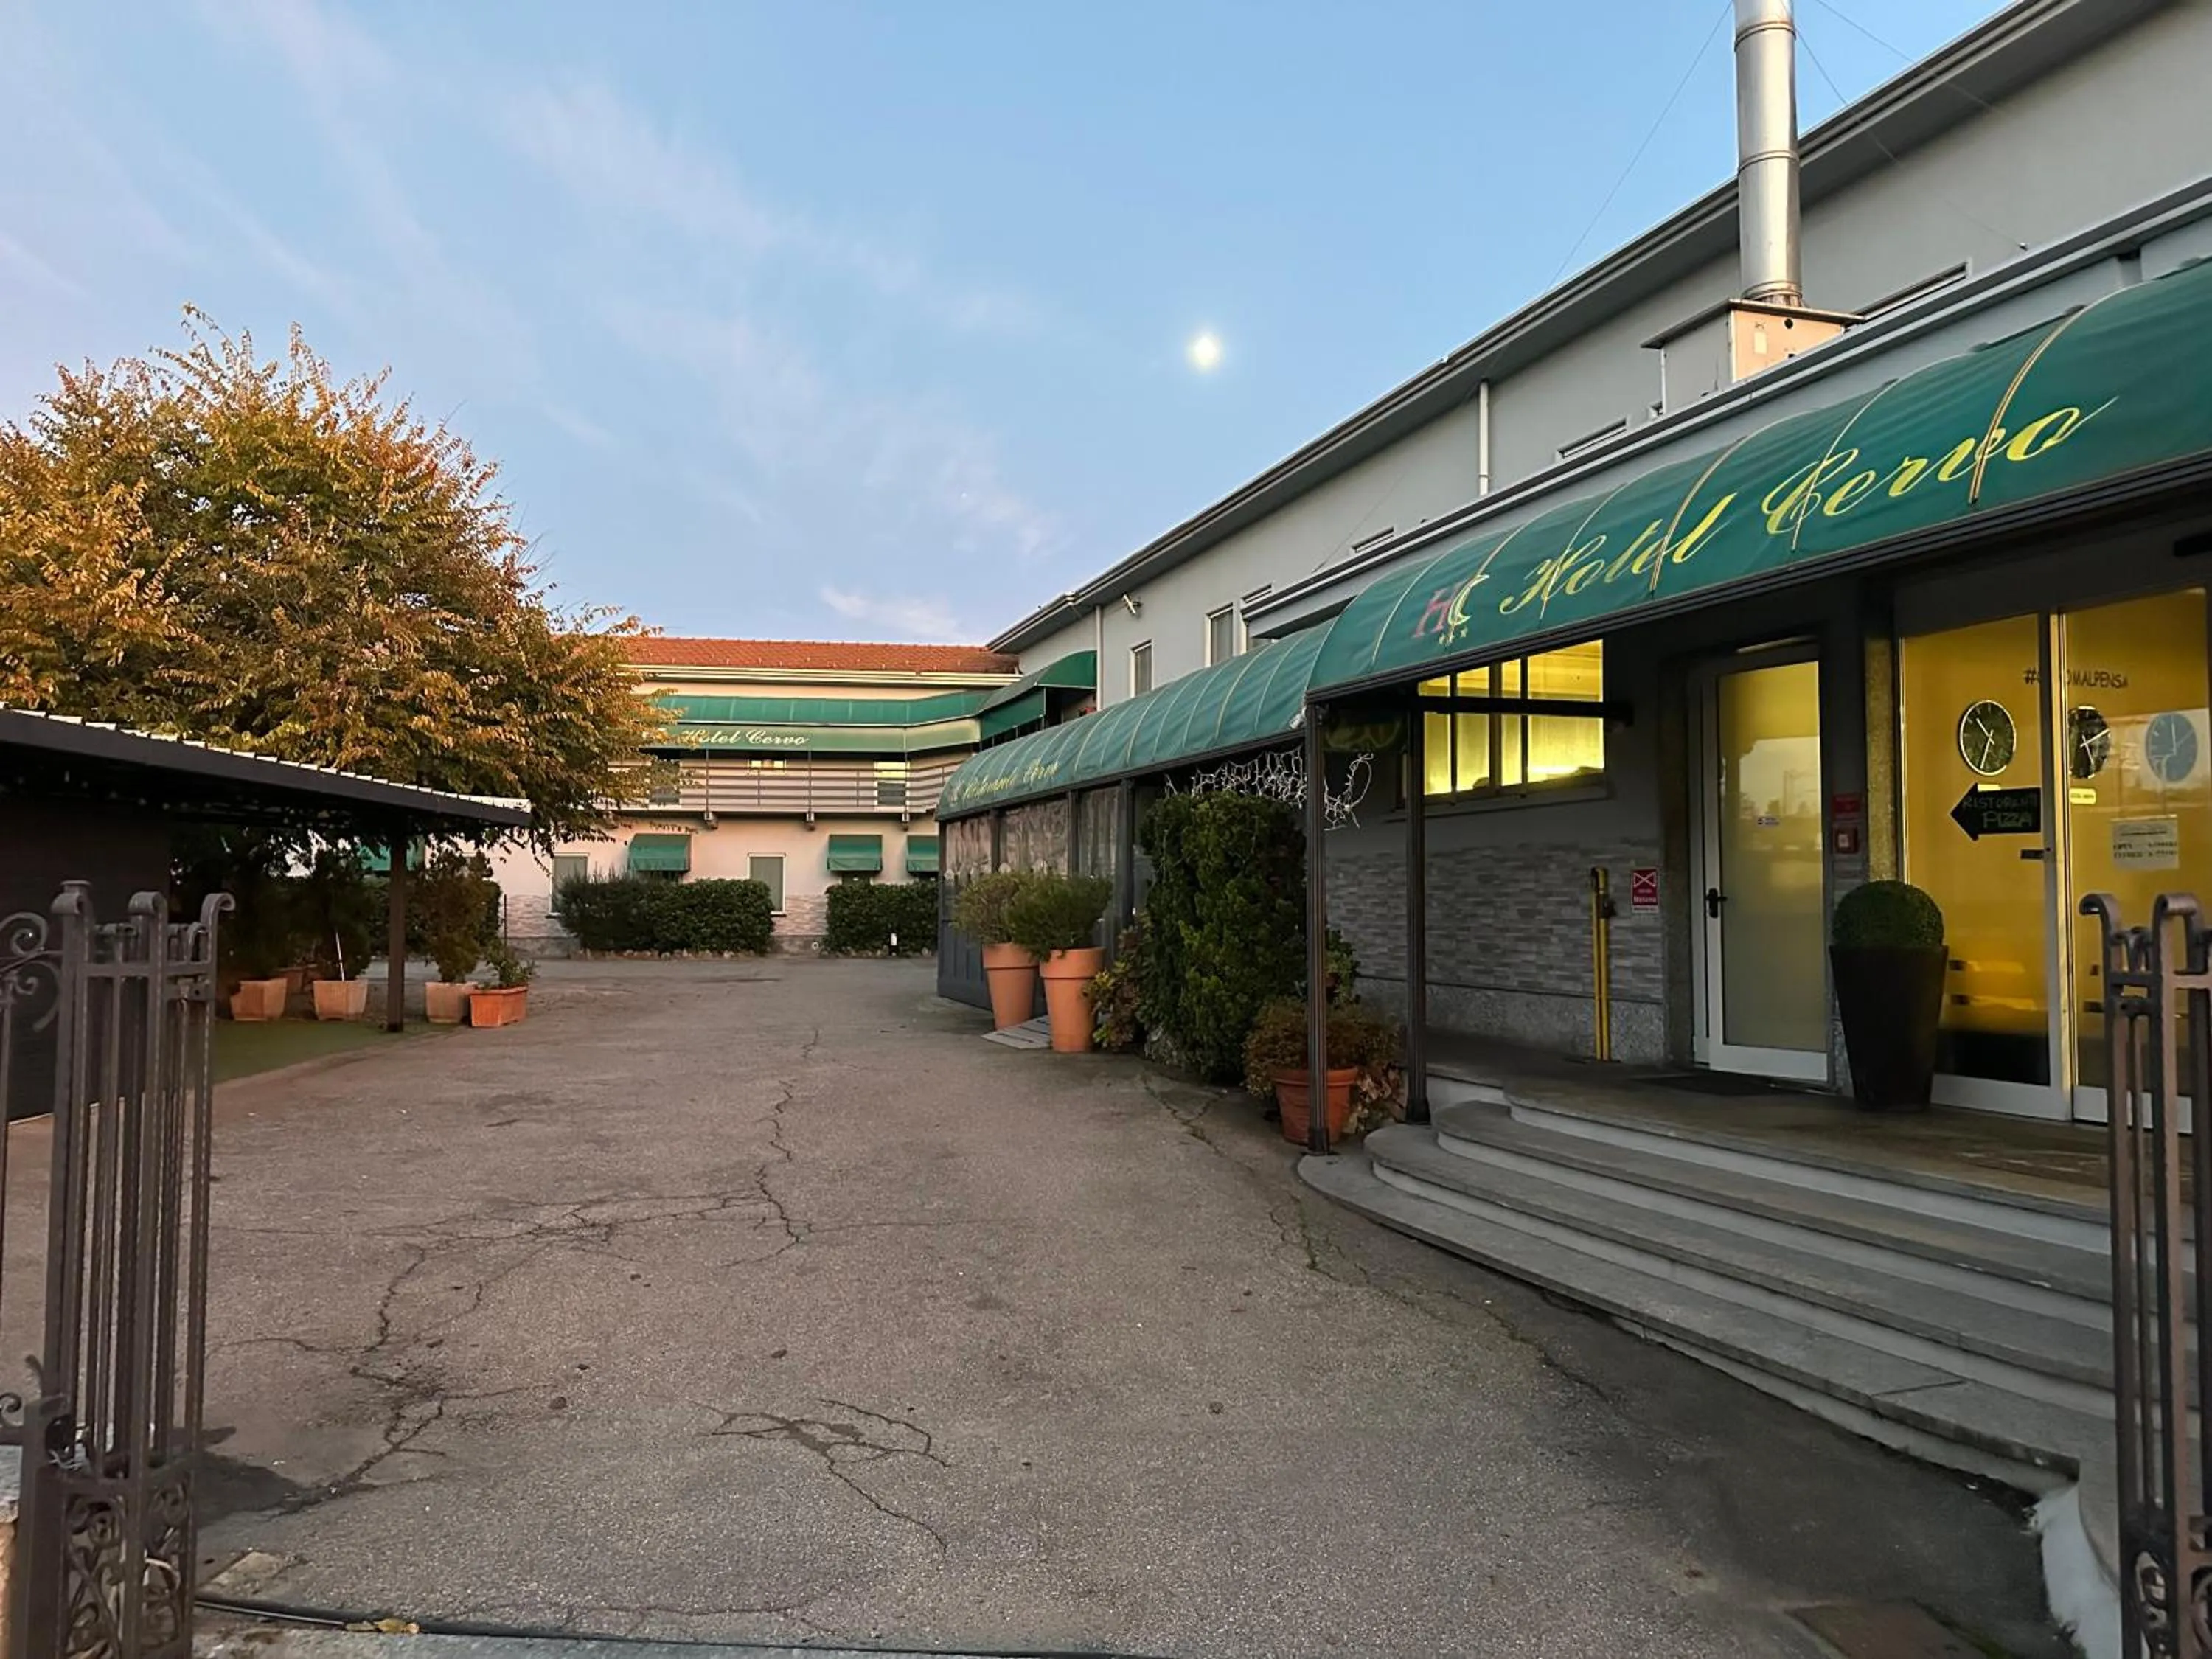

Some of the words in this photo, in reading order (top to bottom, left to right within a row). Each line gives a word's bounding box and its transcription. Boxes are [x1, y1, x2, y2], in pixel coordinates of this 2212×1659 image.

[1499, 492, 1738, 615] Hotel
[1761, 395, 2120, 535] Cervo
[680, 729, 740, 745] Hotel
[1982, 810, 2033, 829] PIZZA
